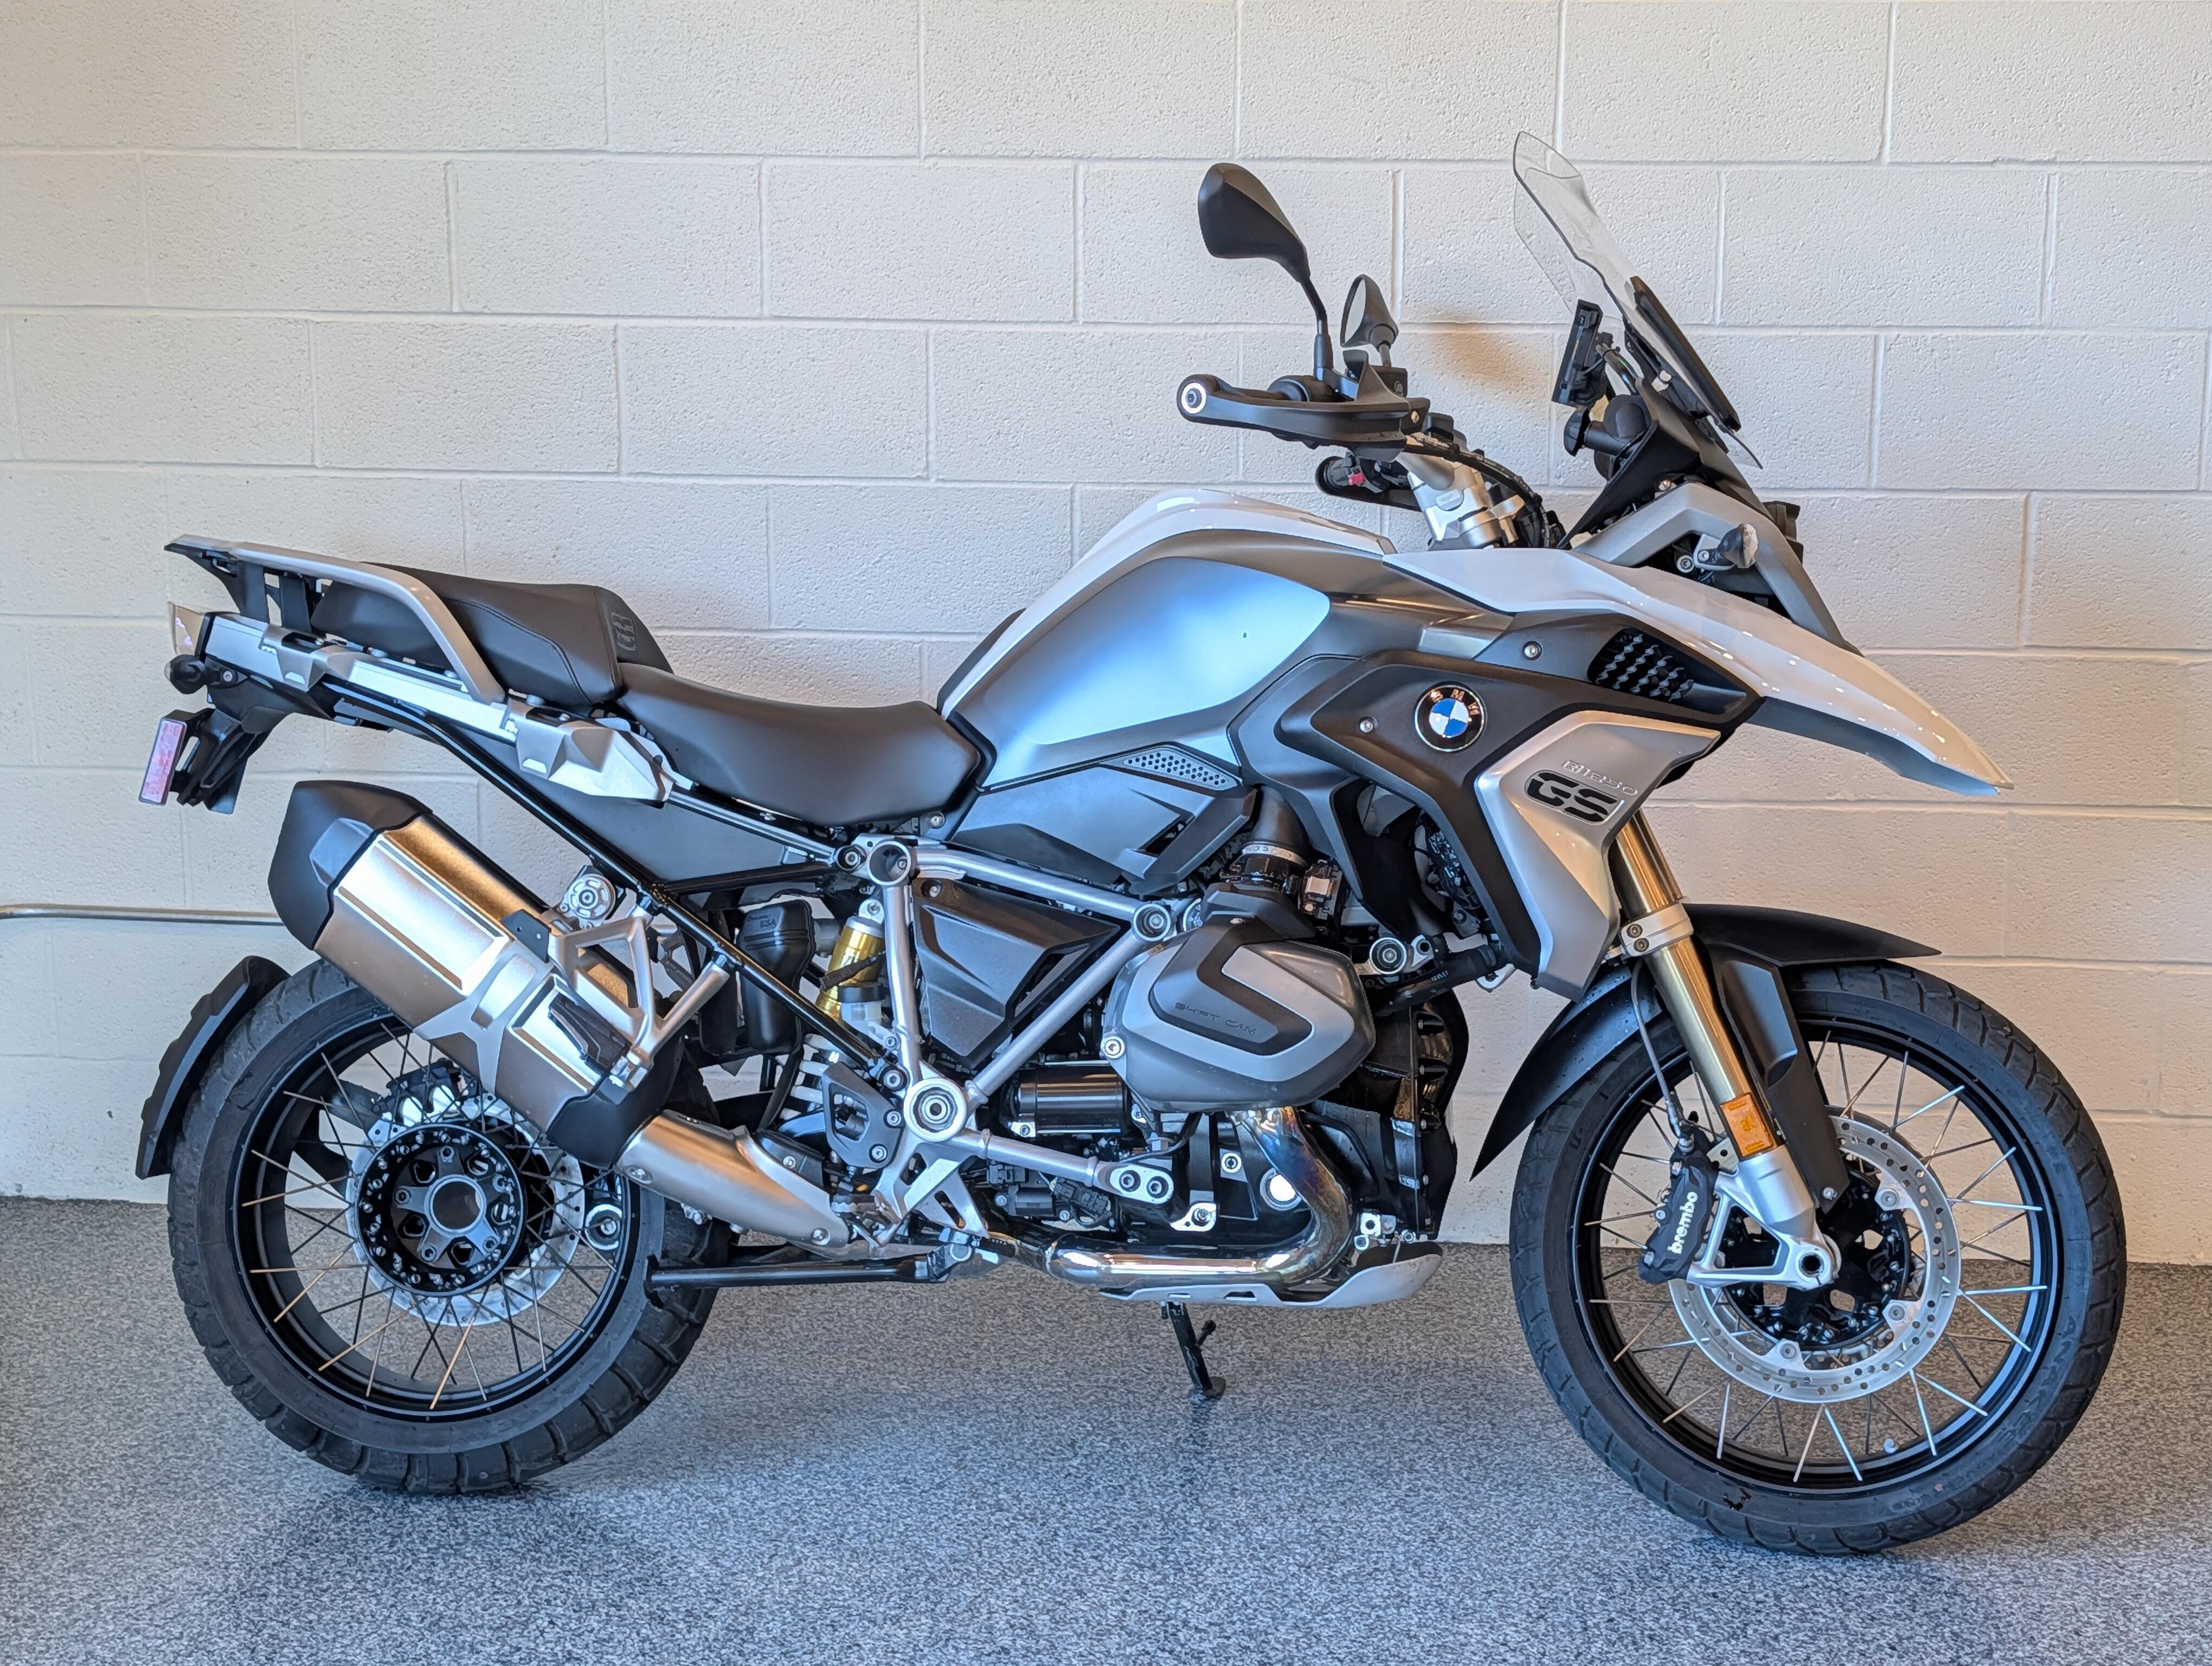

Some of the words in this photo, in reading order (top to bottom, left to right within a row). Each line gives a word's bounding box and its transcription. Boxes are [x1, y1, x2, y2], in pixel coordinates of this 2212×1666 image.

[1527, 772, 1617, 822] GS
[1225, 1019, 1256, 1035] CAM
[1667, 1191, 1698, 1254] brembo
